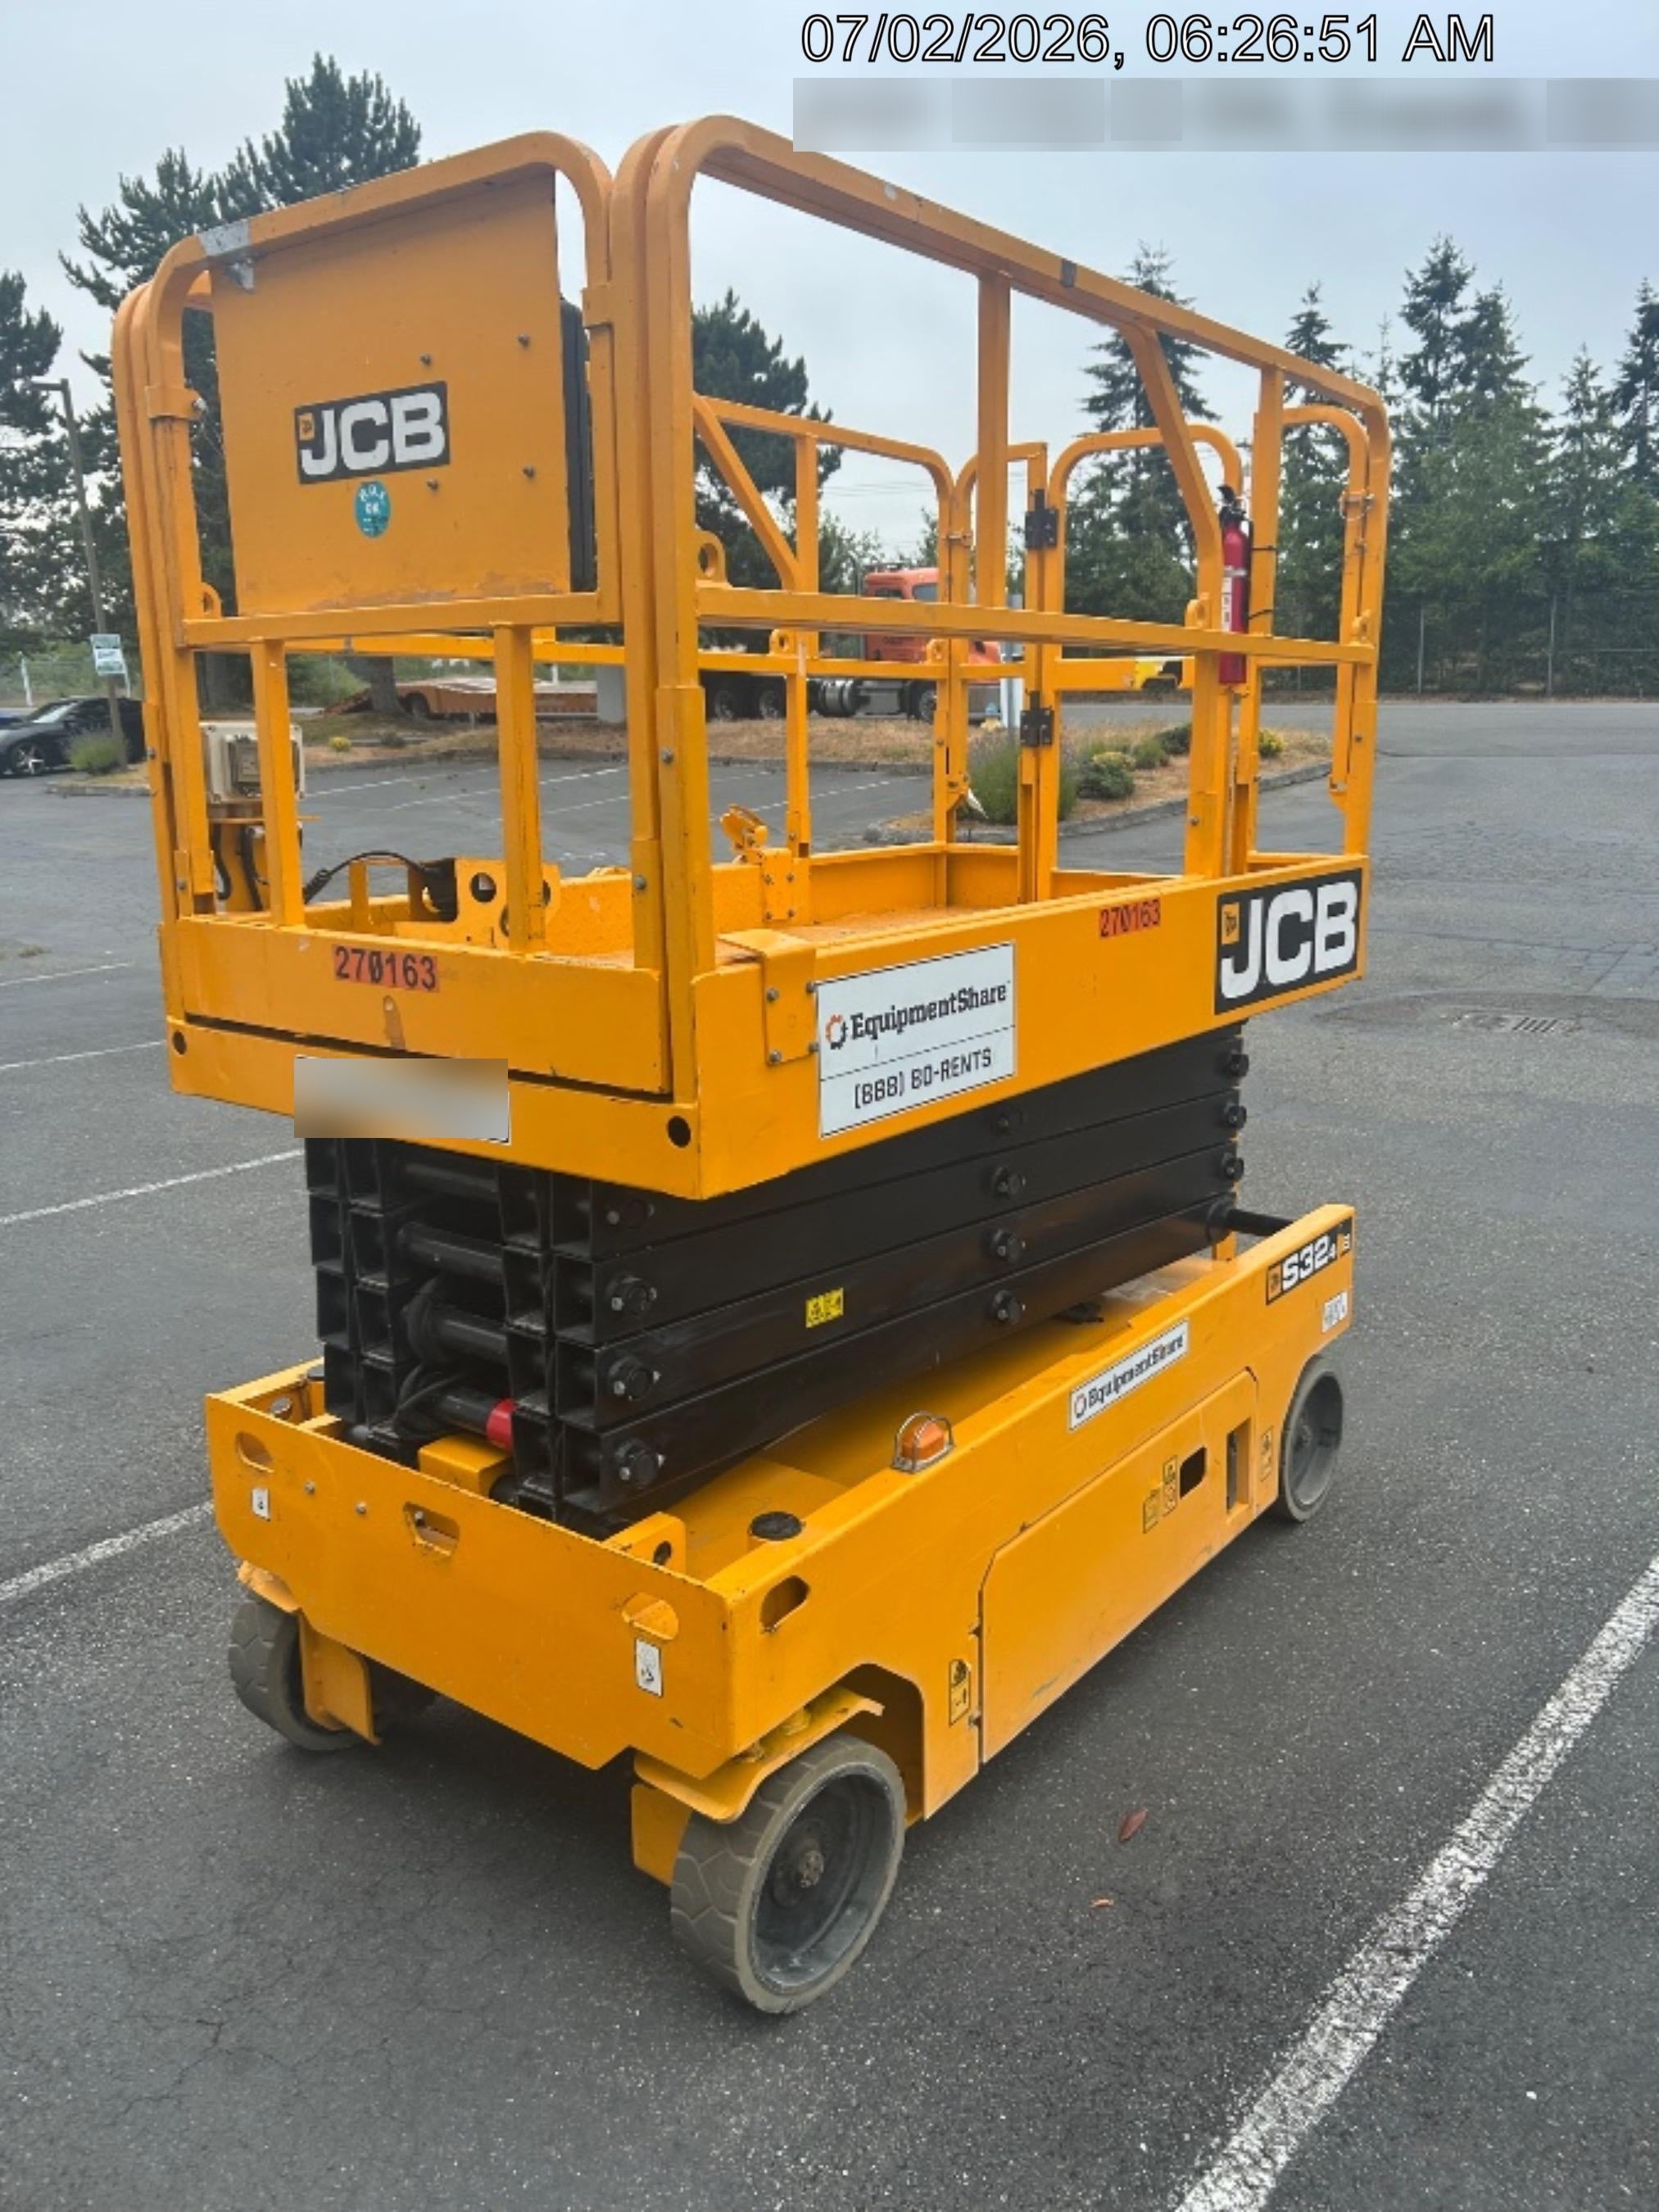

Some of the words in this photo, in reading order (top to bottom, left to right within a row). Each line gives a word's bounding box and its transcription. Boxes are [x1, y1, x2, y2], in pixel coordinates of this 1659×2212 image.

[301, 392, 445, 475] JCB
[1099, 900, 1160, 938] 270163
[1221, 882, 1358, 999] JCB
[335, 946, 436, 990] 270163
[850, 983, 1007, 1040] EquipmentShare
